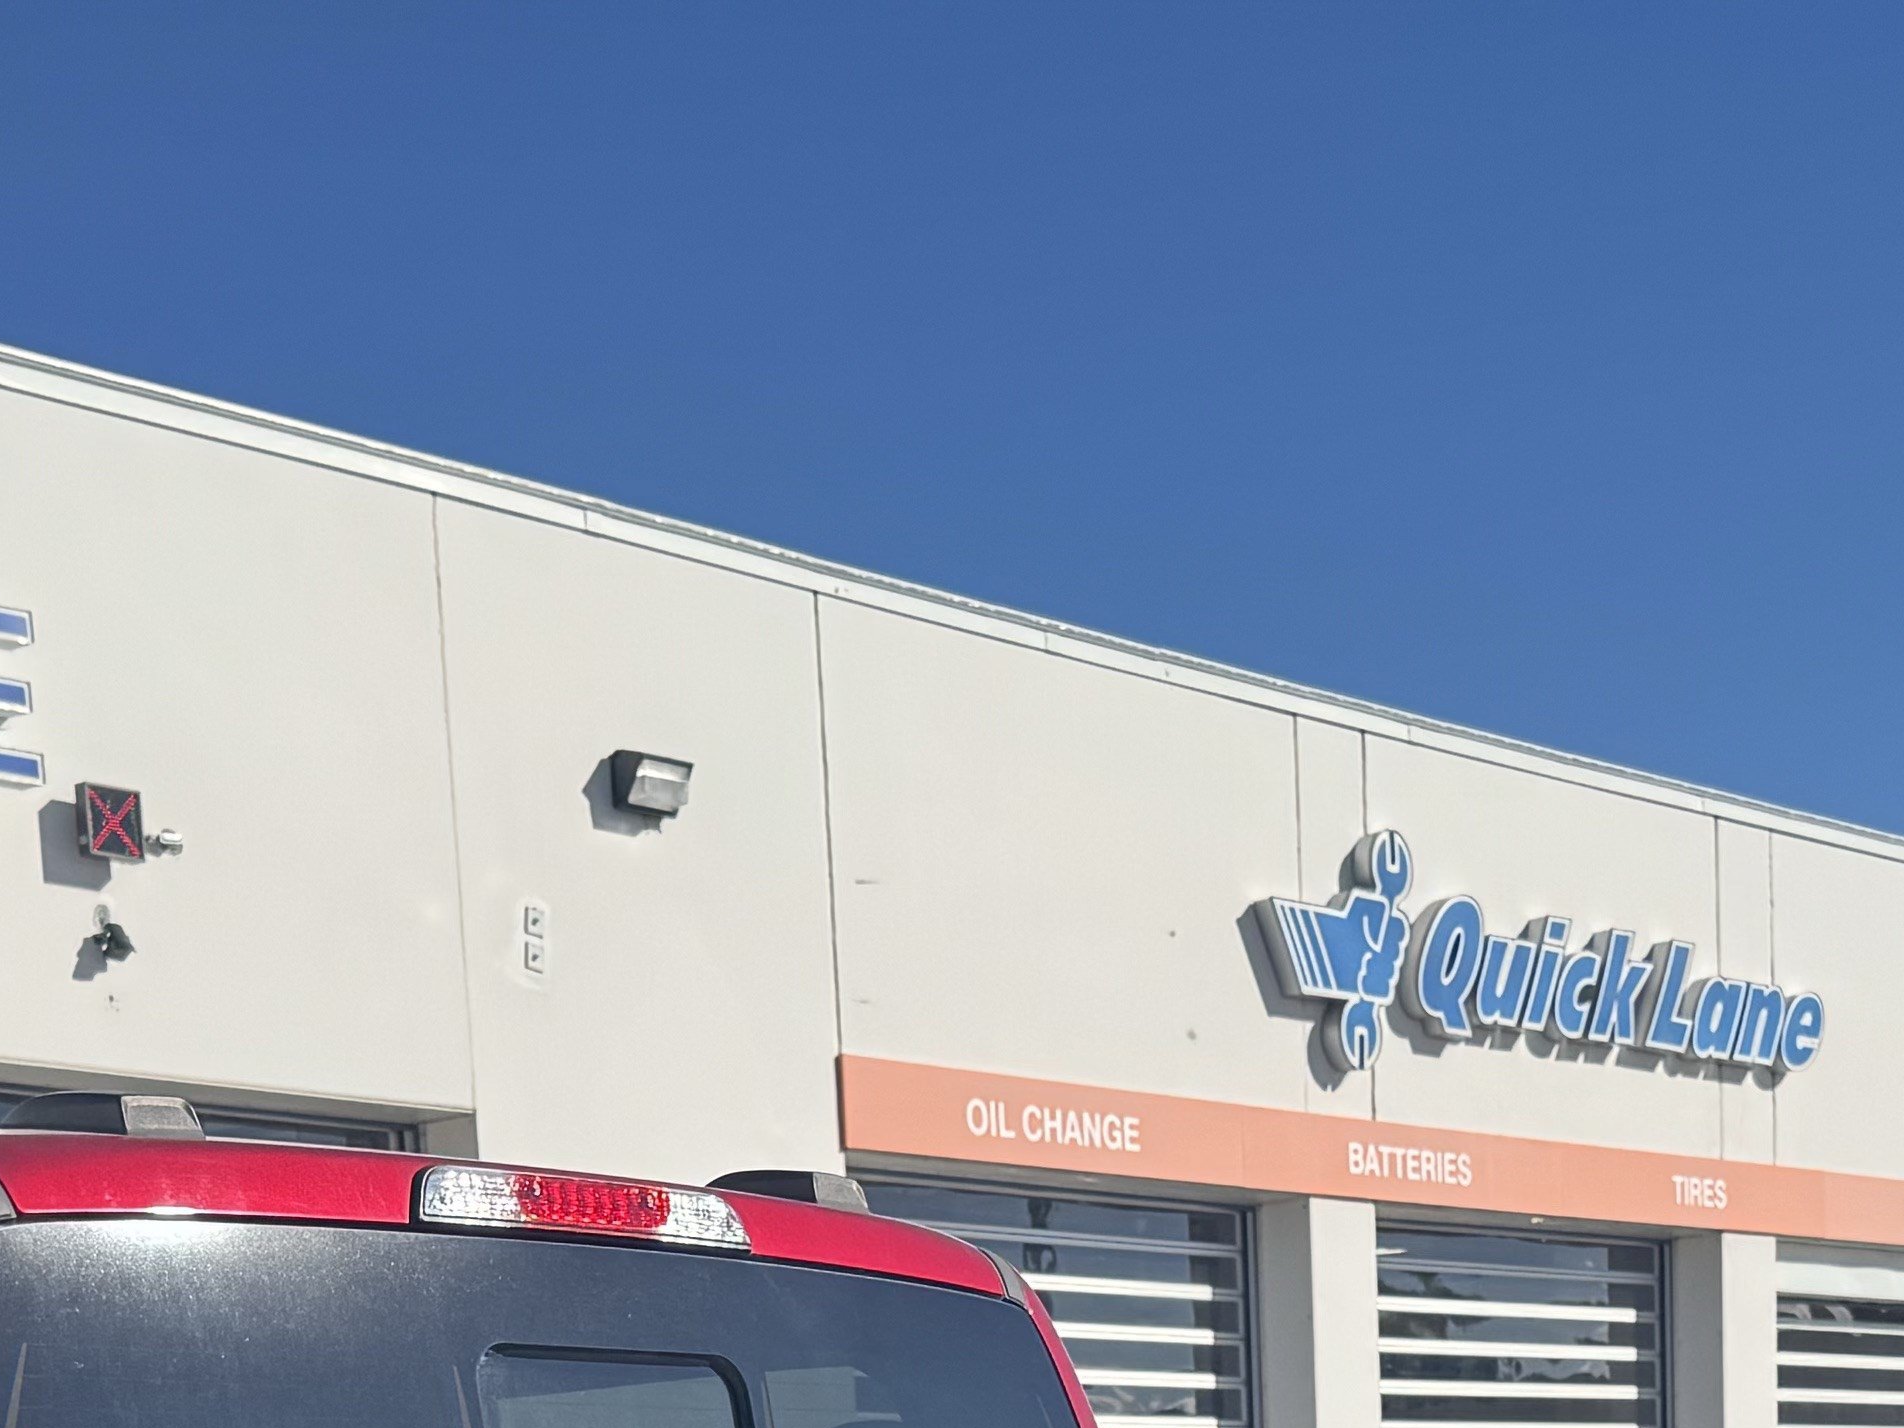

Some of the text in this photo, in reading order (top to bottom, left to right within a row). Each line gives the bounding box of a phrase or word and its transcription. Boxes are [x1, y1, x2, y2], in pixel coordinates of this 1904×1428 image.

[1417, 894, 1825, 1072] Quick Lane
[965, 1097, 1141, 1154] OIL CHANGE
[1347, 1141, 1473, 1188] BATTERIES
[1671, 1175, 1729, 1211] TIRES
